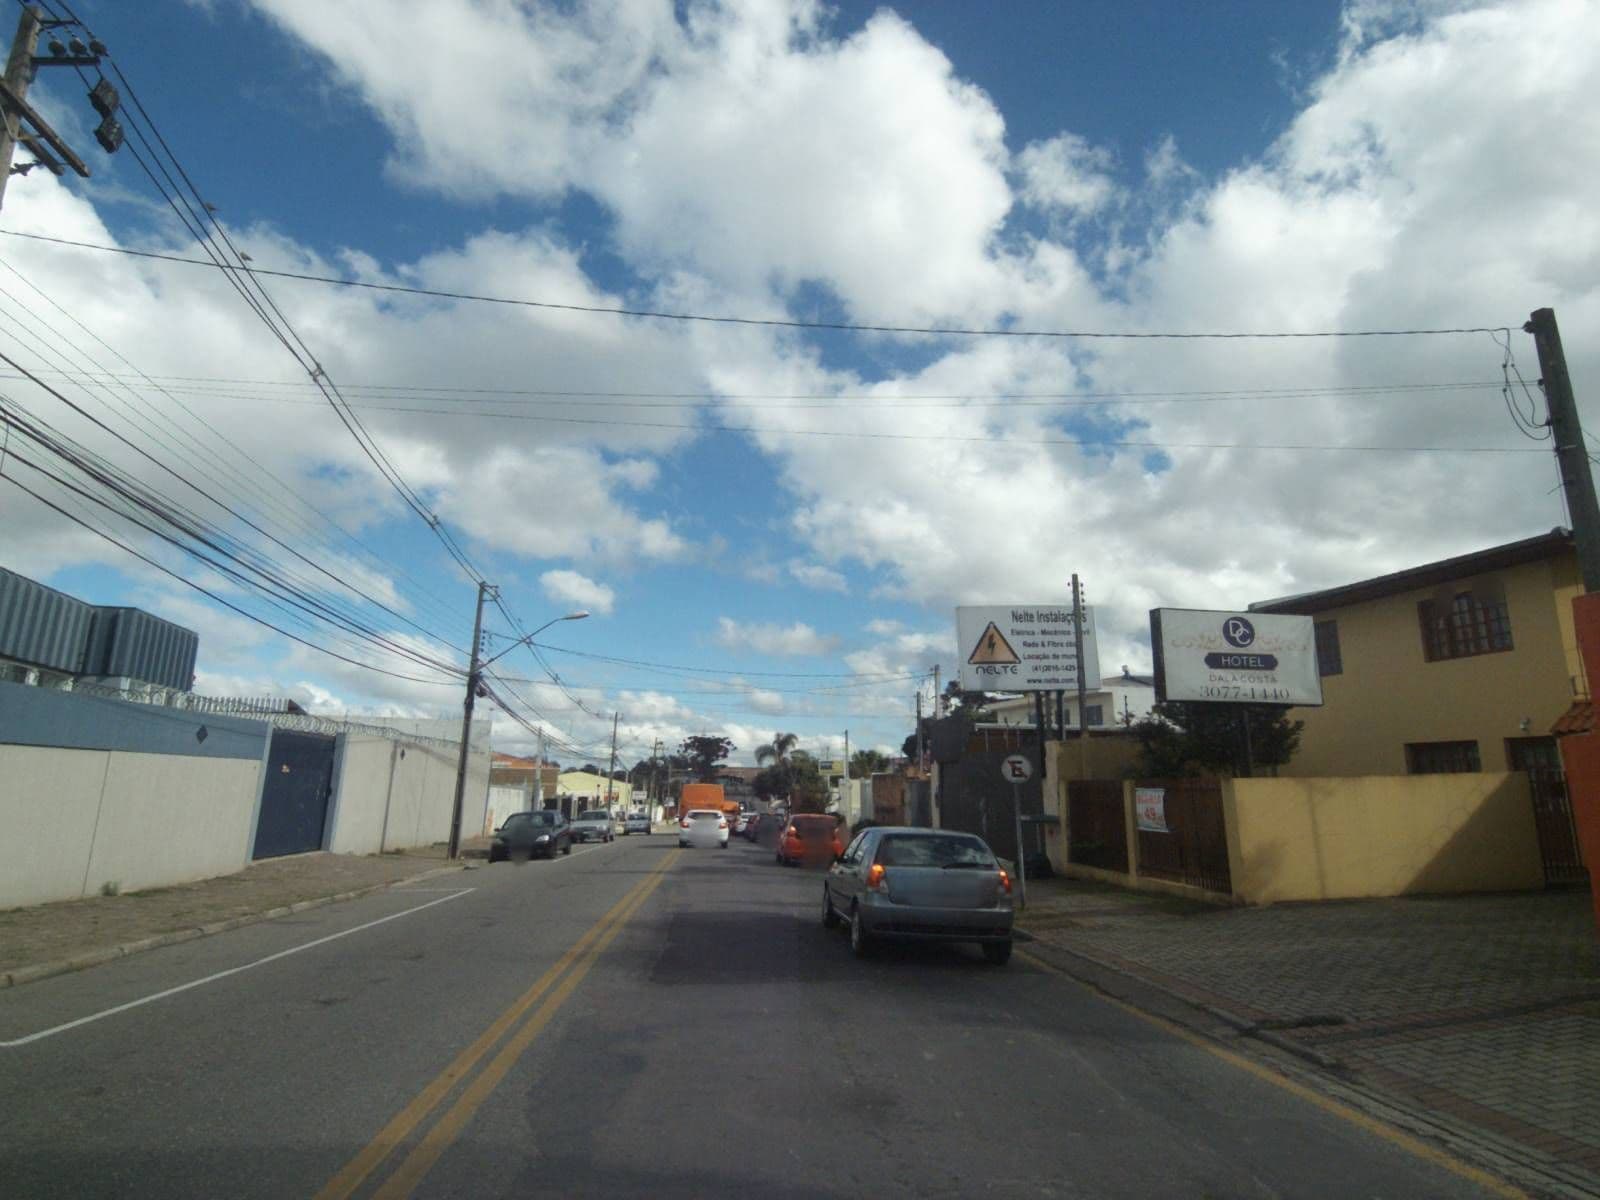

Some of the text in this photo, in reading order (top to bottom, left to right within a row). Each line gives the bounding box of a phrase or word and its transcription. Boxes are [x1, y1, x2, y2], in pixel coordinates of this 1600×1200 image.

[1011, 610, 1087, 625] Nelte Instalaçs
[1221, 656, 1265, 667] HOTEL
